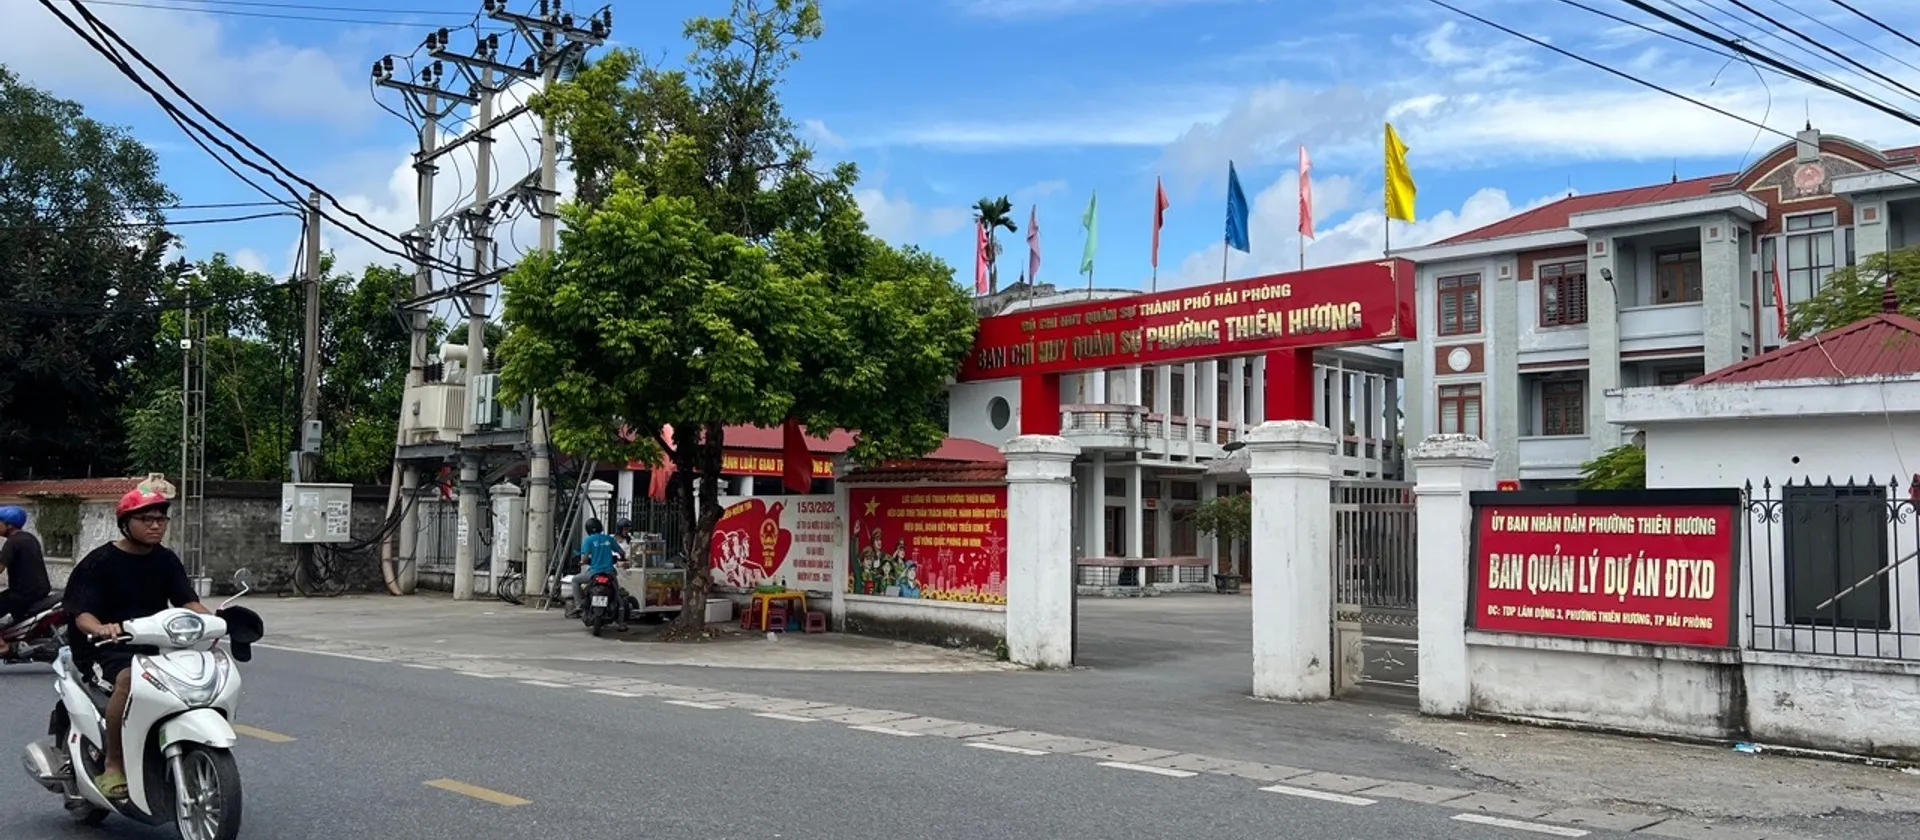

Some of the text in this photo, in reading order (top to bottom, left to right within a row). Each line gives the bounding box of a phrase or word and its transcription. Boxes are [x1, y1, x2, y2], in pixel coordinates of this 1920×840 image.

[1060, 313, 1082, 327] HUY
[1085, 307, 1117, 325] QUÂN
[1119, 305, 1137, 321] SỰ
[1139, 298, 1181, 316] THÀNH
[1184, 290, 1211, 310] PHỐ
[1214, 286, 1238, 306] HẢI
[1242, 283, 1292, 302] PHÒNG
[977, 301, 1363, 370] BAN CHỈ HUY QUÂN SỰ PHƯỜNG THIÊN HƯƠNG
[739, 455, 757, 472] LUẬT
[758, 457, 776, 471] GIAO
[1491, 510, 1716, 535] ỦY BAN NHÂN DÂN PHƯỜNG THIÊN HƯƠNG
[1488, 543, 1716, 602] BAN QUẢN LÝ DỰ ÁN ĐTXD
[1502, 605, 1516, 616] TDP
[1556, 608, 1564, 620] 3,
[1565, 608, 1597, 622] PHƯỜNG
[1598, 609, 1621, 623] THIÊN
[1622, 612, 1653, 626] HƯƠNG,
[1654, 614, 1665, 626] TP
[1666, 611, 1681, 627] HẢI
[1682, 614, 1713, 629] PHÒNG
